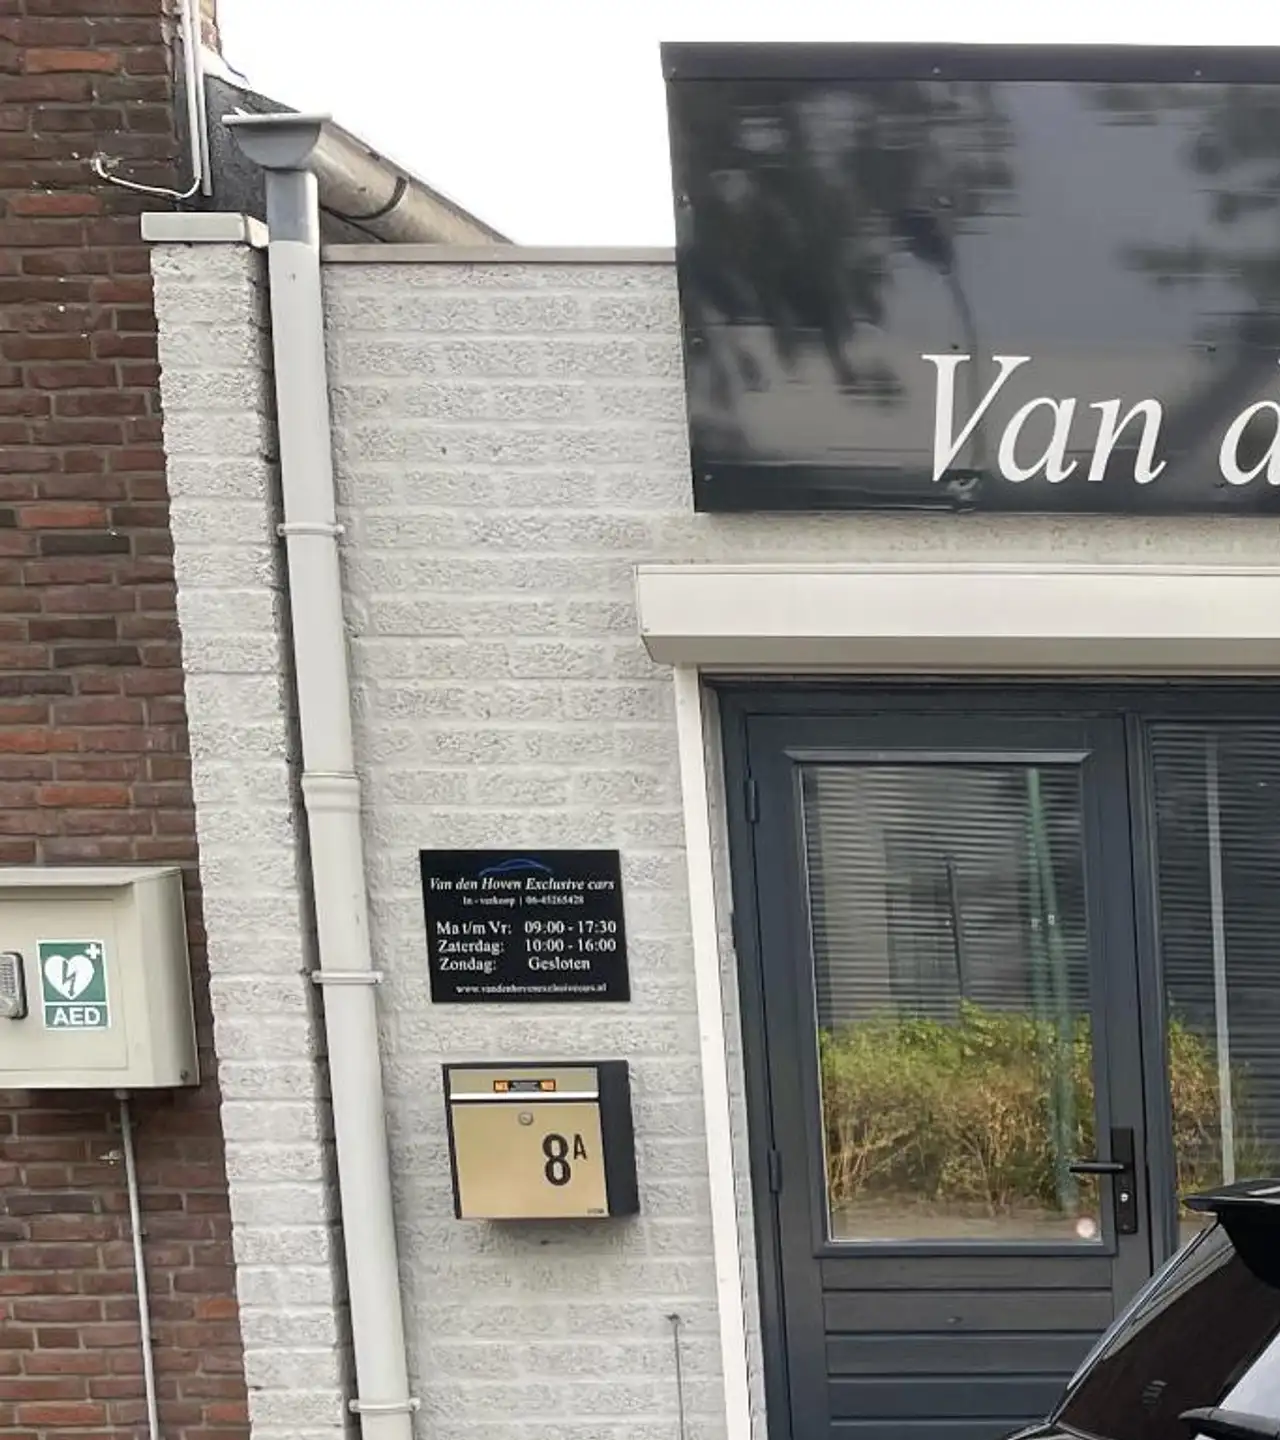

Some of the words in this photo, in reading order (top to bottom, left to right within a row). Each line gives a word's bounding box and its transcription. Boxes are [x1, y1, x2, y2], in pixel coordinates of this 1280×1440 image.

[921, 353, 1167, 484] Van
[431, 877, 453, 890] Van
[456, 877, 478, 890] den
[481, 877, 521, 890] Hoven
[525, 877, 584, 890] Exclusive
[587, 880, 615, 890] cars
[436, 921, 459, 935] Ma
[462, 921, 485, 935] t/m
[488, 921, 512, 935] Vr:
[524, 920, 565, 934] 09:00
[578, 920, 617, 934] 17:30
[438, 939, 504, 956] Zaterdag:
[526, 938, 565, 952] 10:00
[578, 938, 617, 952] 16:00
[440, 957, 497, 974] Zondag:
[528, 956, 591, 971] Gesloten
[52, 1006, 101, 1025] AED
